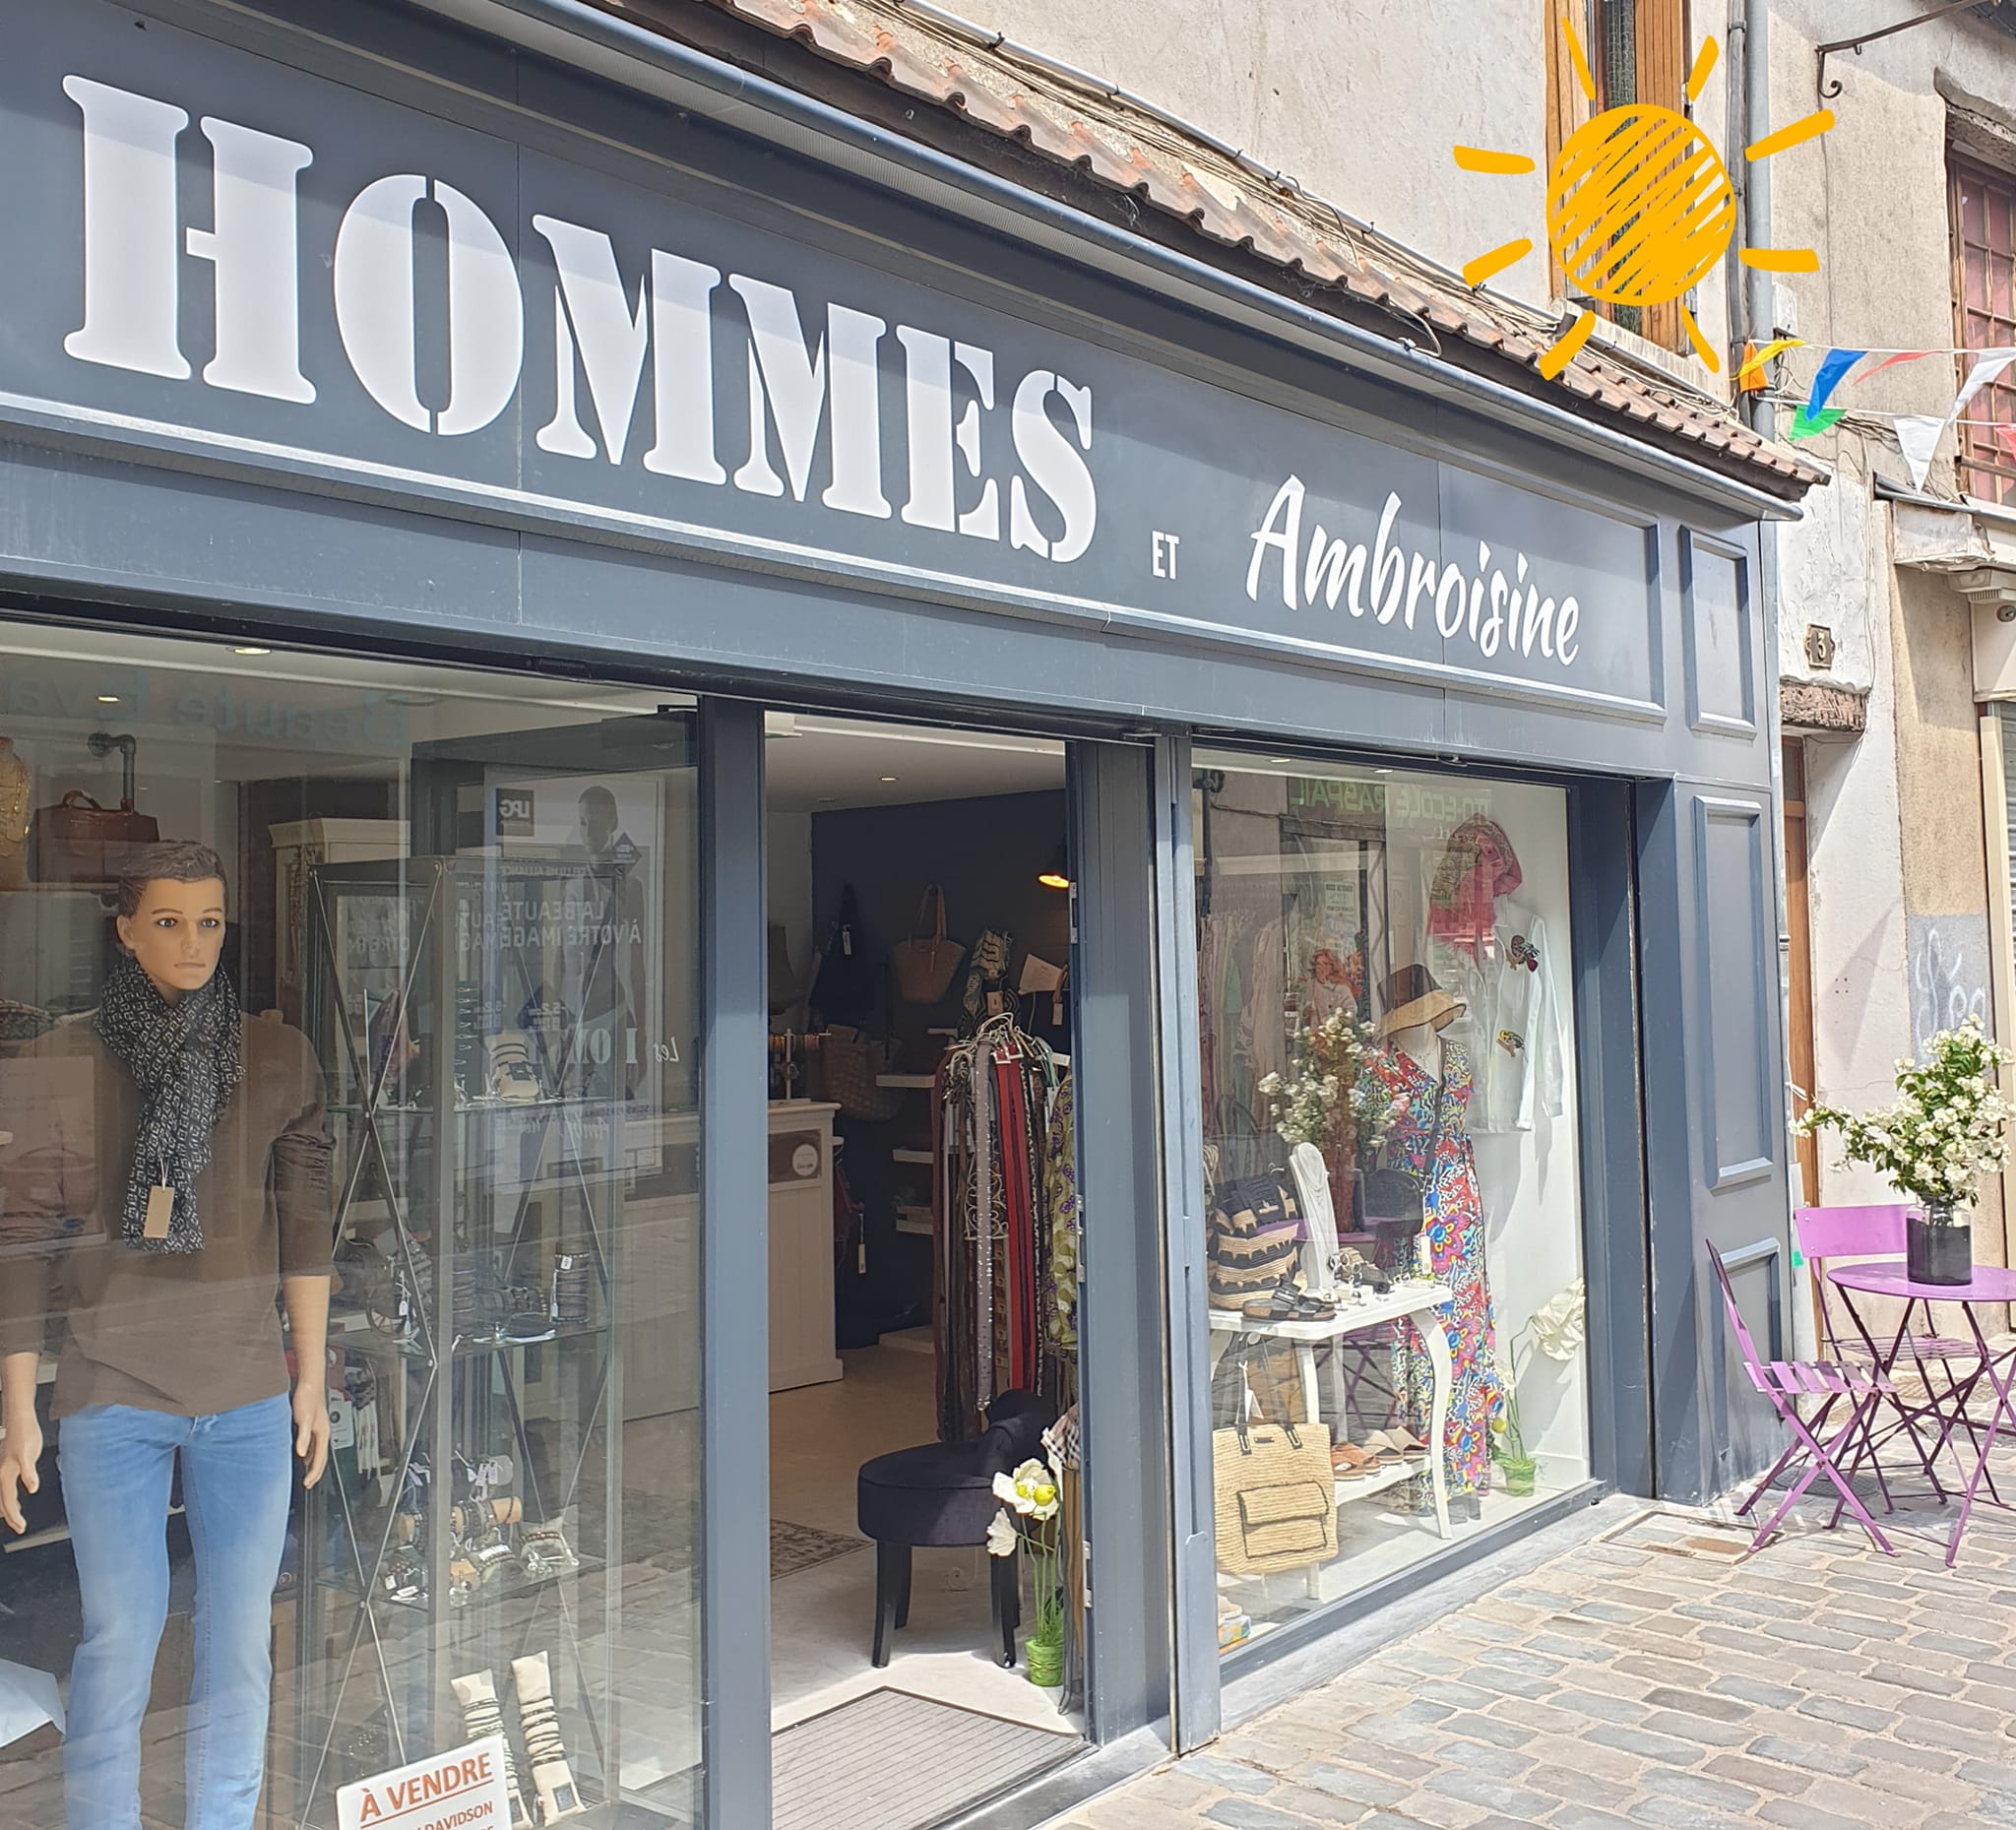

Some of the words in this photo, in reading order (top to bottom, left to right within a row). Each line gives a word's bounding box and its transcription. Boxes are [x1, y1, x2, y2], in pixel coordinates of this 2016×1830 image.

[62, 74, 1097, 563] HOMMES
[1151, 530, 1180, 580] ET
[1246, 473, 1581, 666] Ambroisine
[359, 1787, 382, 1822] À
[386, 1752, 493, 1810] VENDRE
